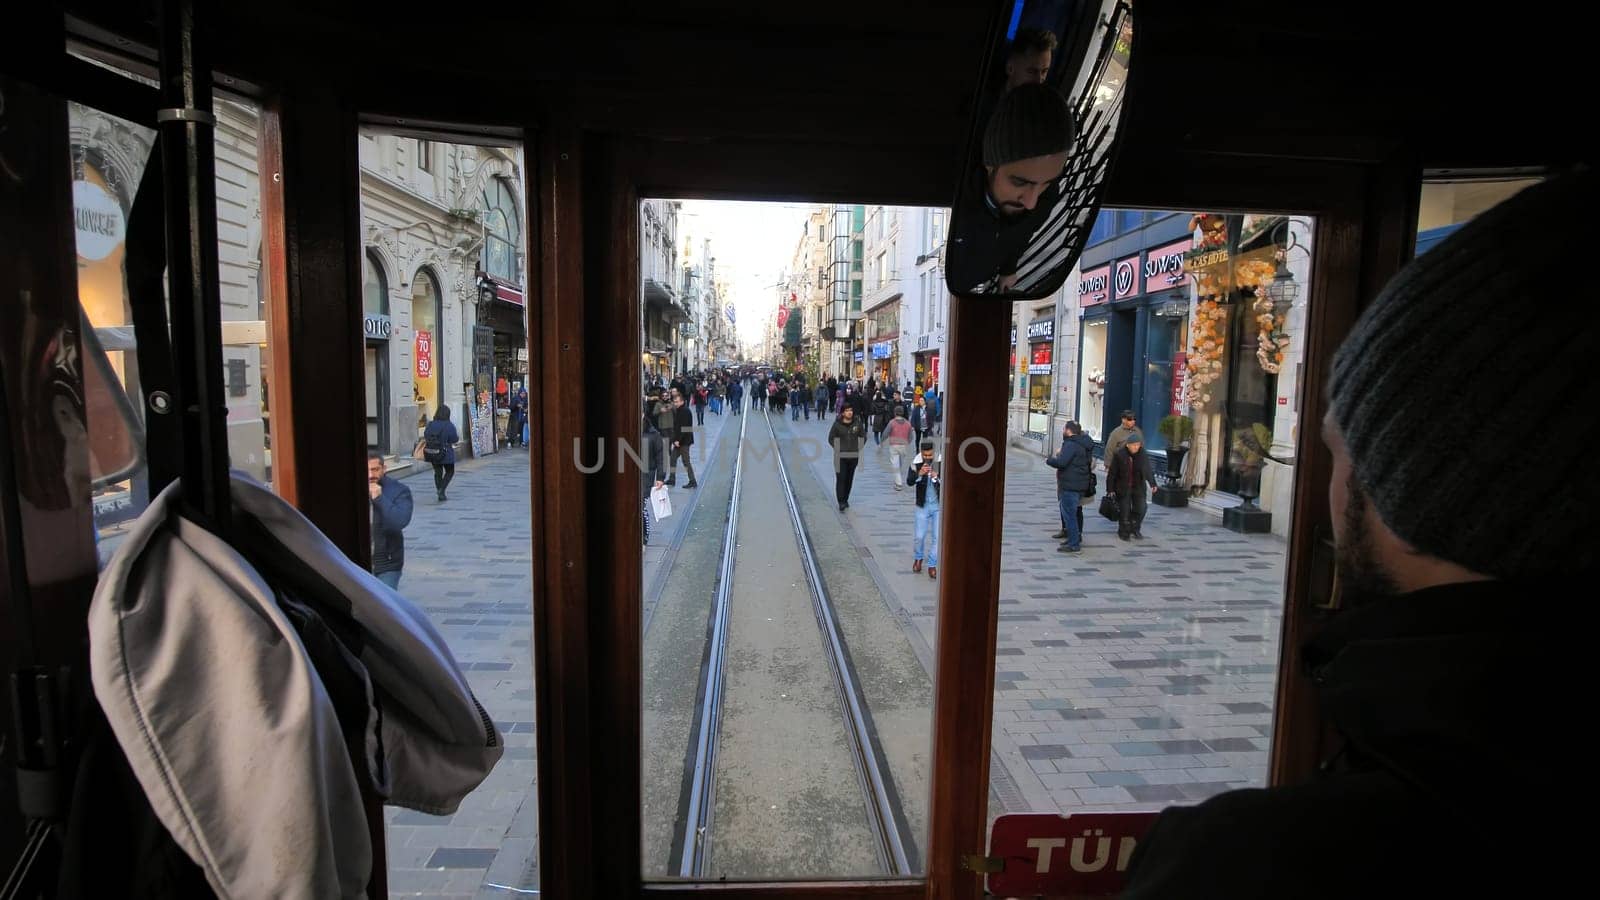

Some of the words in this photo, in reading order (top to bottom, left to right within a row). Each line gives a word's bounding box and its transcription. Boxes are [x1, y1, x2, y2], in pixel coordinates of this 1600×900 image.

[1145, 250, 1184, 278] SUWEN
[1077, 274, 1106, 295] SUWEN
[1027, 321, 1052, 338] CHANGE
[419, 340, 429, 353] 70
